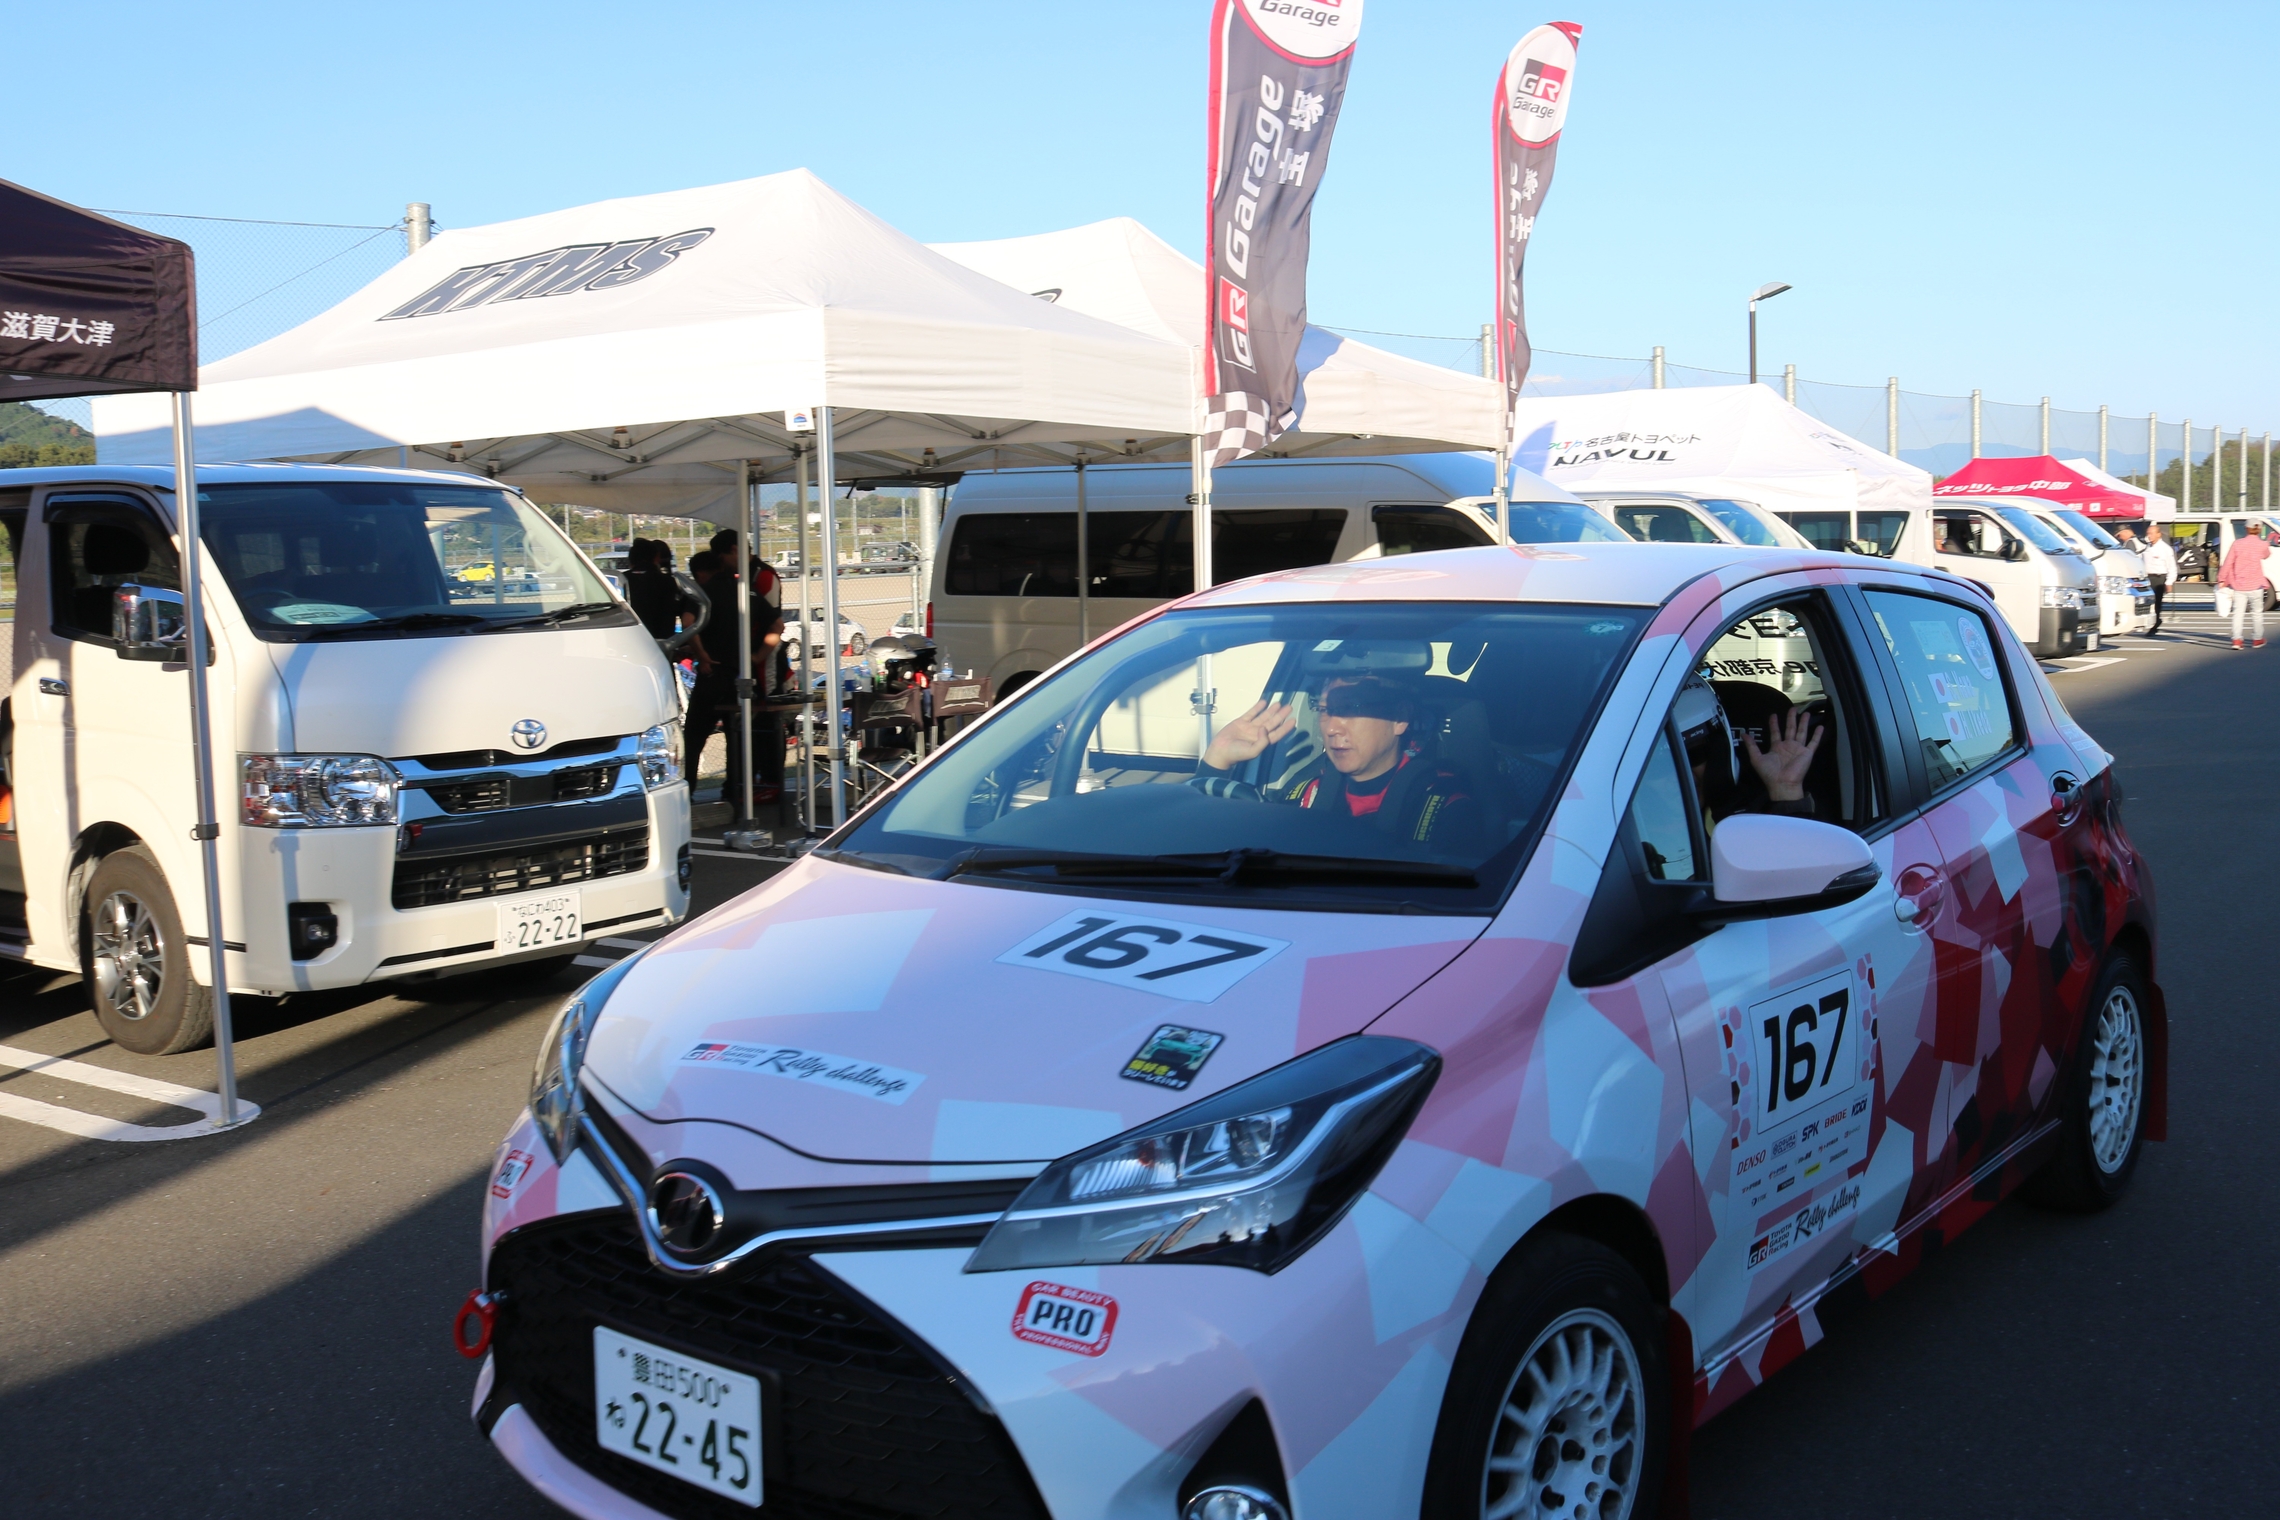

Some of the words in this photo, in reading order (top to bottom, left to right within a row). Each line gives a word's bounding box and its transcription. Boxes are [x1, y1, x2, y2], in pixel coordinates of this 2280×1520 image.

[1259, 0, 1340, 27] Garage
[1518, 69, 1563, 102] GR
[1513, 96, 1555, 119] Garage
[1278, 89, 1325, 187] 宝塚
[1226, 75, 1284, 279] Garage
[379, 227, 715, 320] KTMS
[0, 310, 116, 347] 滋賀大津
[1224, 282, 1255, 369] GR
[1585, 431, 1702, 448] 名古屋トヨペット
[519, 912, 577, 948] 22-22
[1022, 916, 1268, 981] 167
[755, 1048, 829, 1079] Rally
[1763, 987, 1848, 1114] 167
[1736, 1148, 1767, 1177] DENSO
[1801, 1119, 1820, 1143] SPK
[1824, 1108, 1848, 1129] BRIDE
[1770, 1222, 1792, 1240] TOYOTA
[1793, 1203, 1827, 1243] Rally
[1031, 1282, 1060, 1295] CAR
[1030, 1298, 1095, 1337] PRO
[630, 1391, 750, 1490] 22-45
